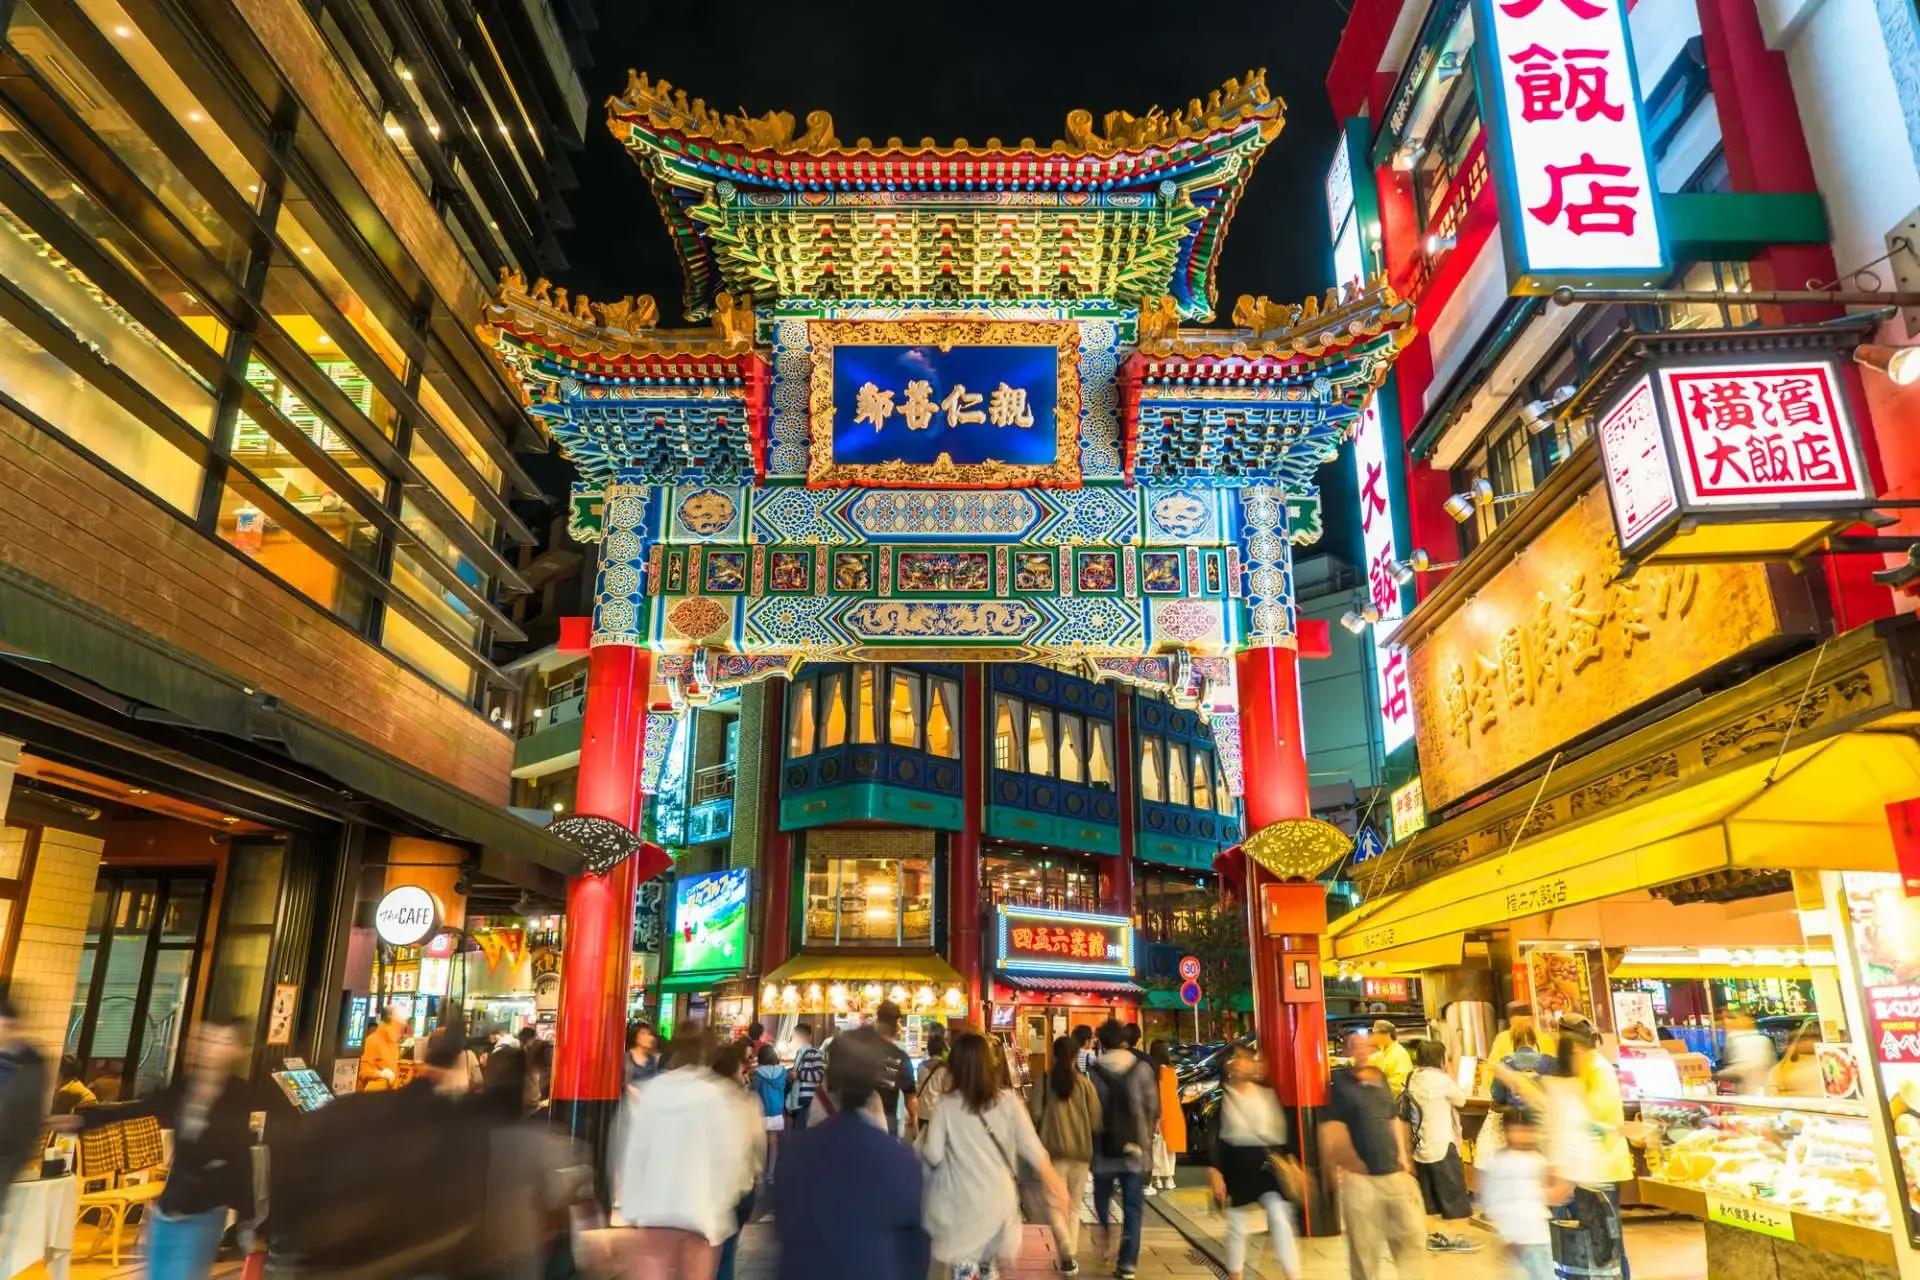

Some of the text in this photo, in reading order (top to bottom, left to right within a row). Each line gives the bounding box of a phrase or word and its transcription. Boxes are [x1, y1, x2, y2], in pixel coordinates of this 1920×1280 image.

[1704, 432, 1839, 485] 大飯店
[380, 906, 430, 925] The CAFE
[1184, 963, 1196, 974] 30
[1719, 1202, 1781, 1228] 食べ放題メニュー
